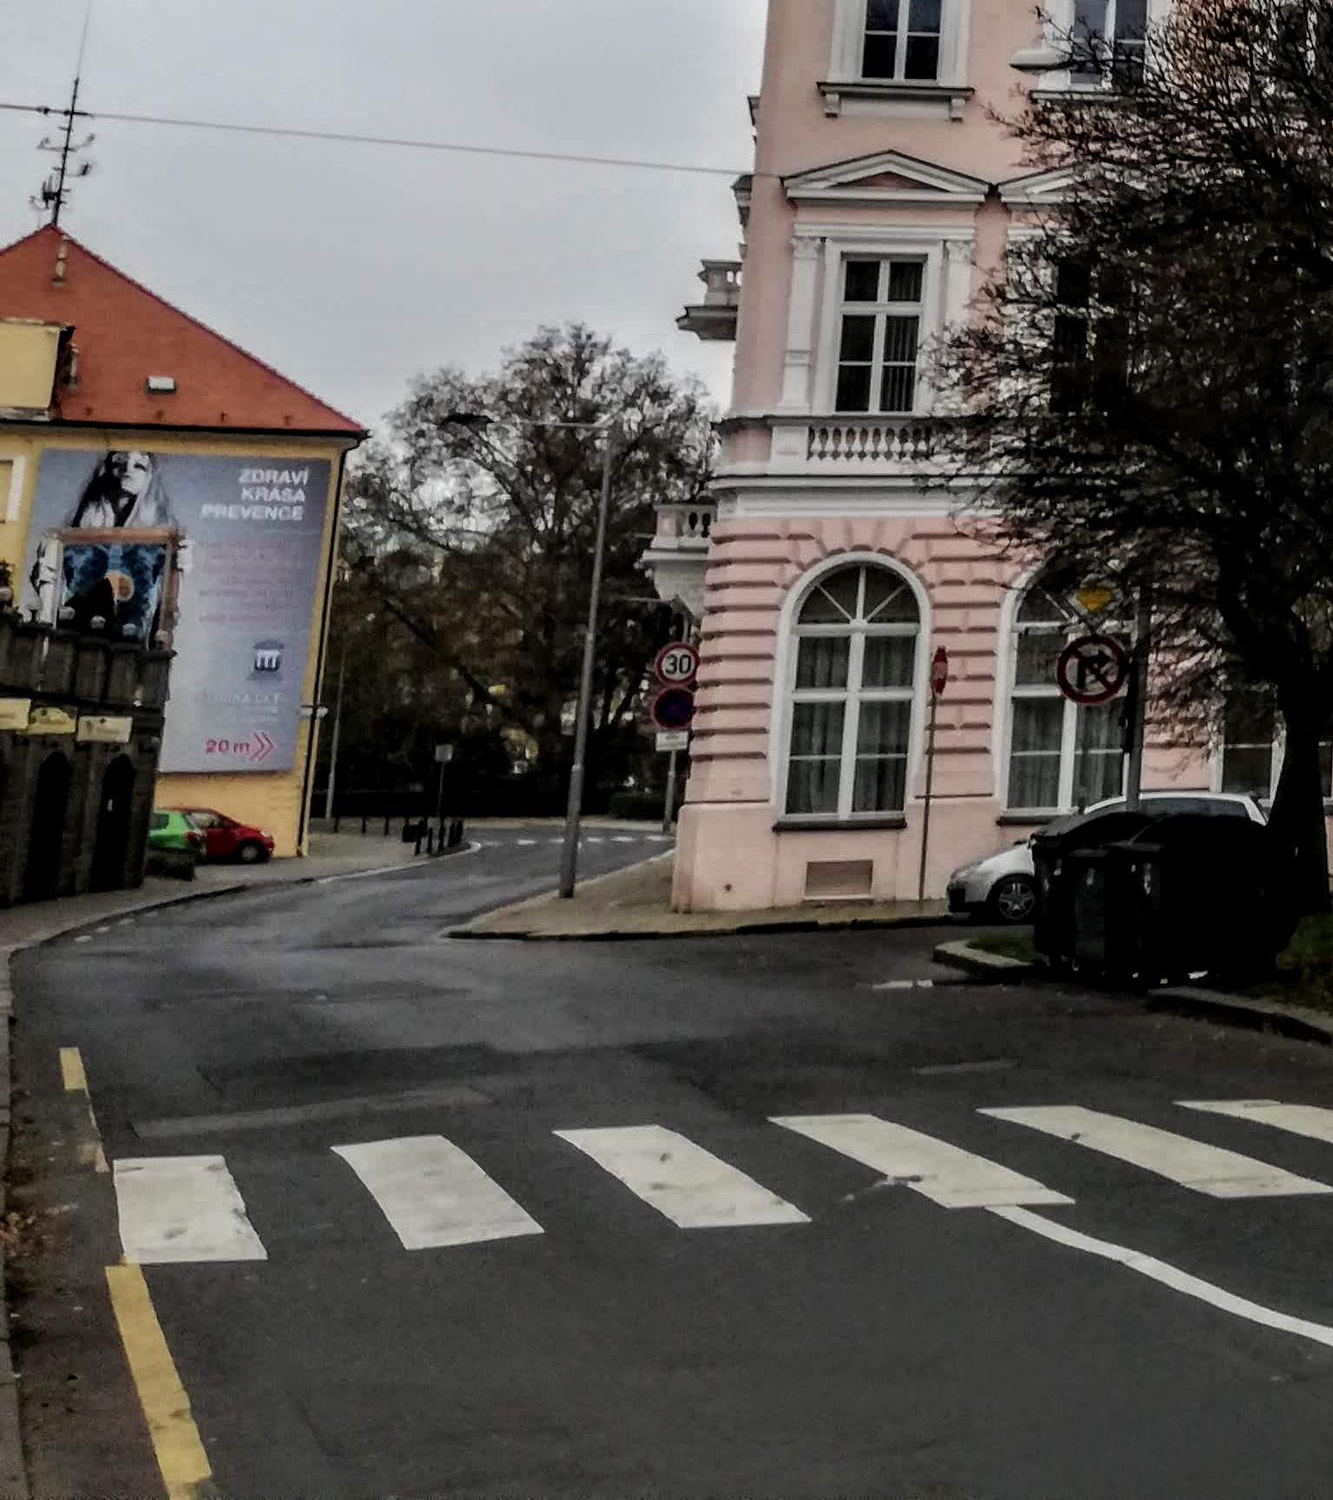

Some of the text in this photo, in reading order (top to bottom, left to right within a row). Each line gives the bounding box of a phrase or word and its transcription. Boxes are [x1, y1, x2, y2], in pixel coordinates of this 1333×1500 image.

[200, 503, 304, 521] PREVENCE
[665, 654, 691, 674] 30
[205, 739, 250, 754] 20 m
